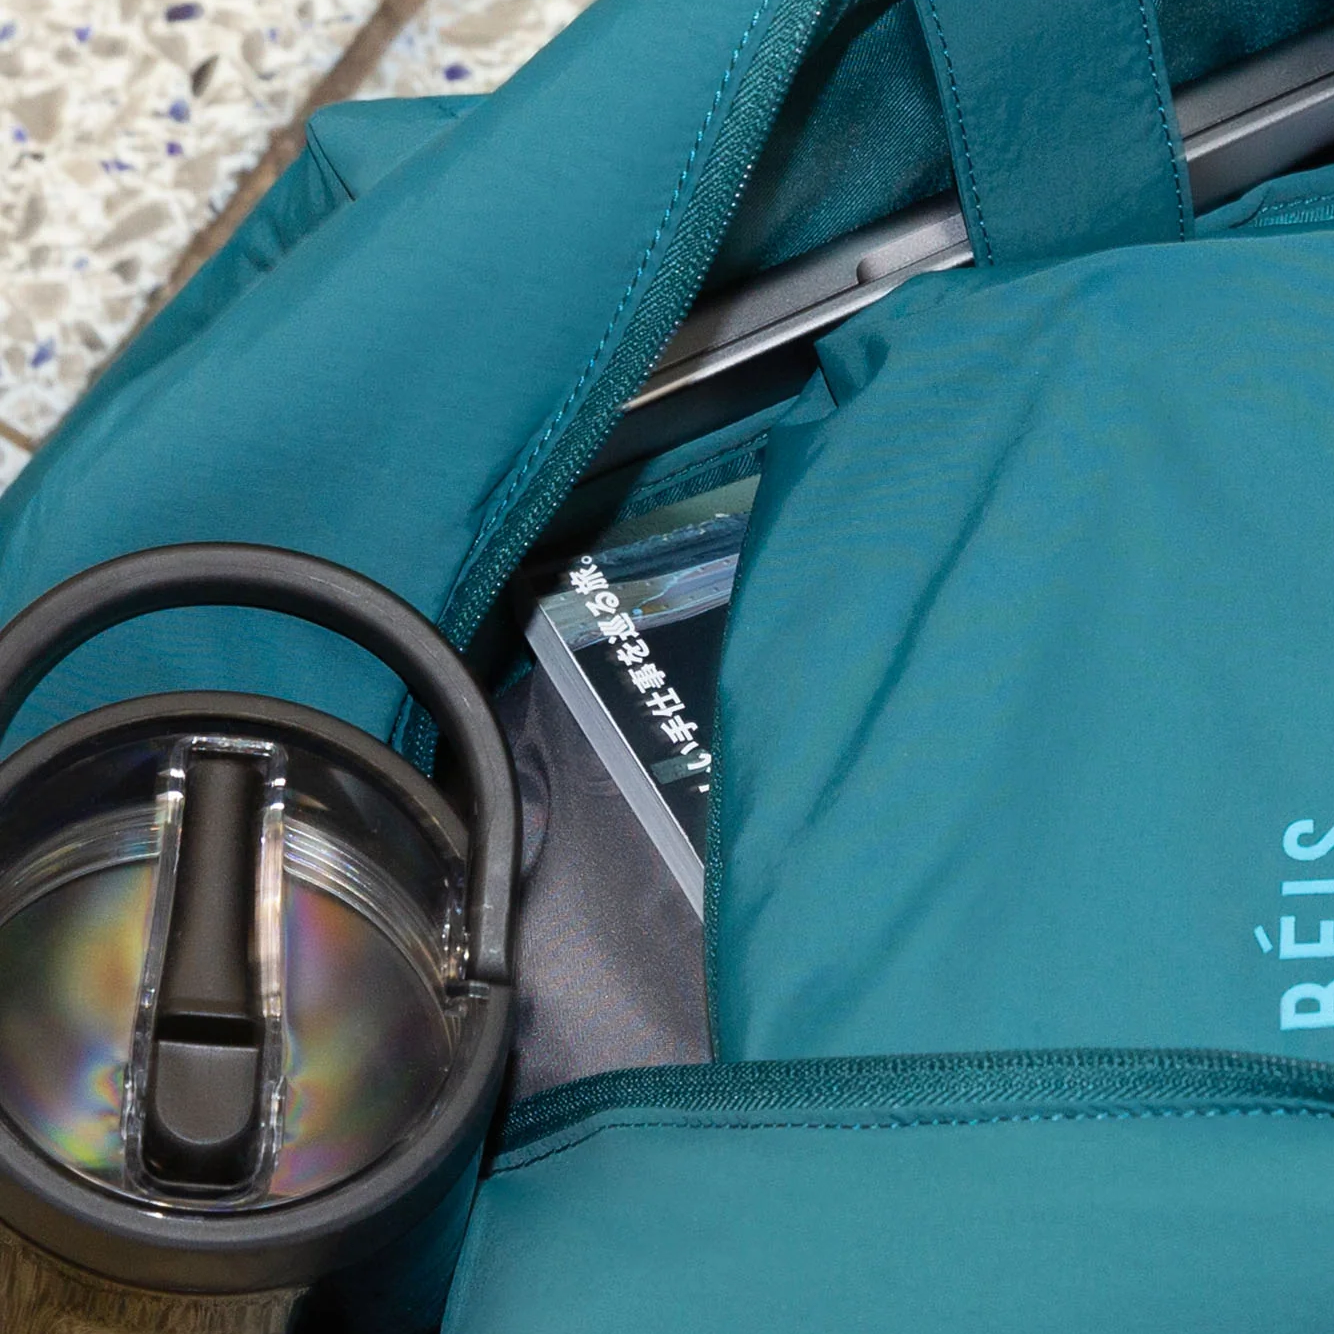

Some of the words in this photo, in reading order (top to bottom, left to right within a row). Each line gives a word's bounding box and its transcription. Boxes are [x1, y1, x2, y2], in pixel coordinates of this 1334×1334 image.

[569, 553, 713, 793] い手仕事を巡る旅。
